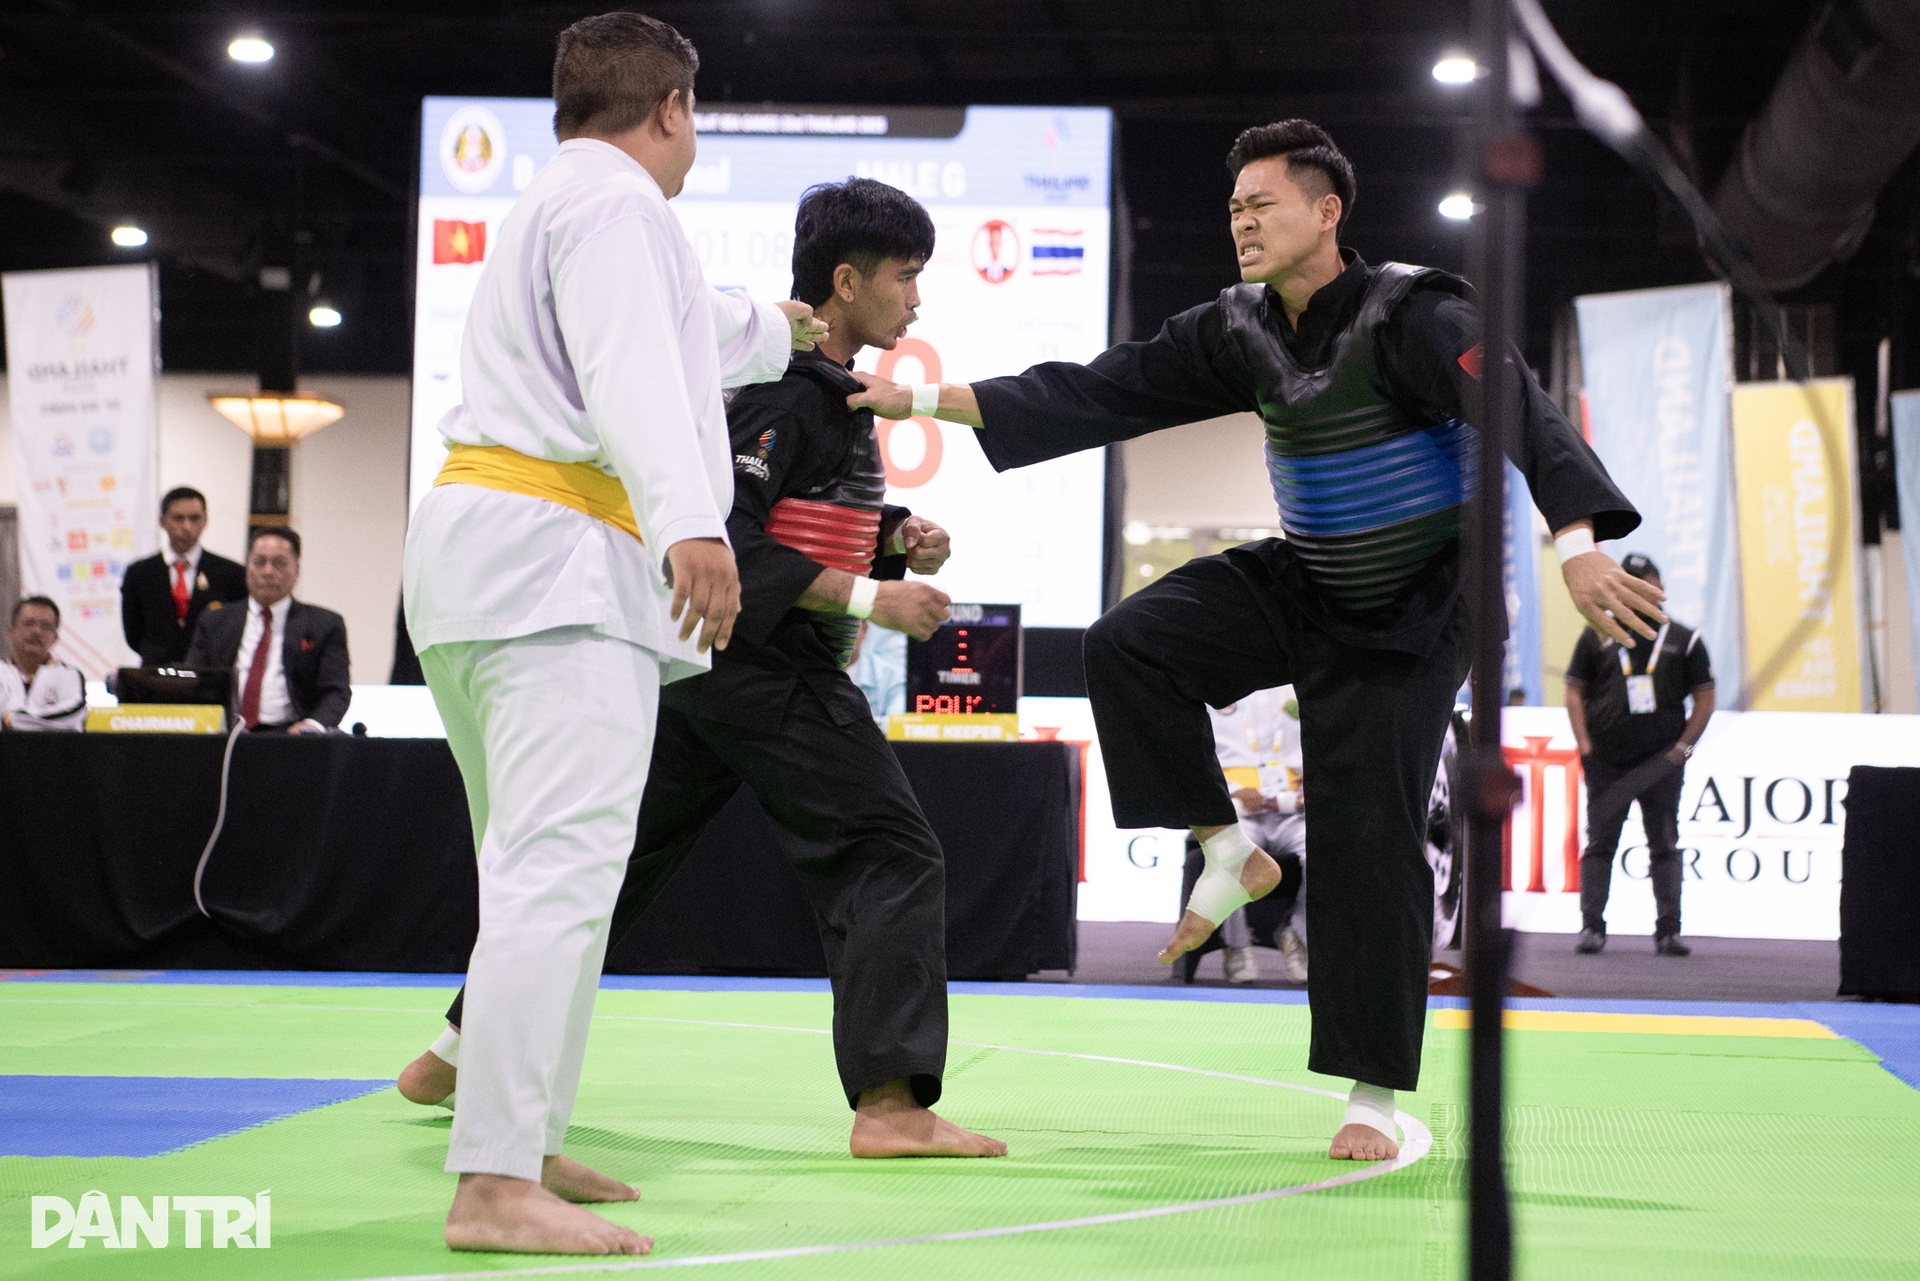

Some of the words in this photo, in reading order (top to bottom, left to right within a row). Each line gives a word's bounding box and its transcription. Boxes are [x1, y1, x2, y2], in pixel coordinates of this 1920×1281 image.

[110, 716, 196, 731] CHAIRMAN
[903, 724, 940, 738] TIME
[943, 725, 1003, 739] KEEPER
[1621, 846, 1843, 883] GROU
